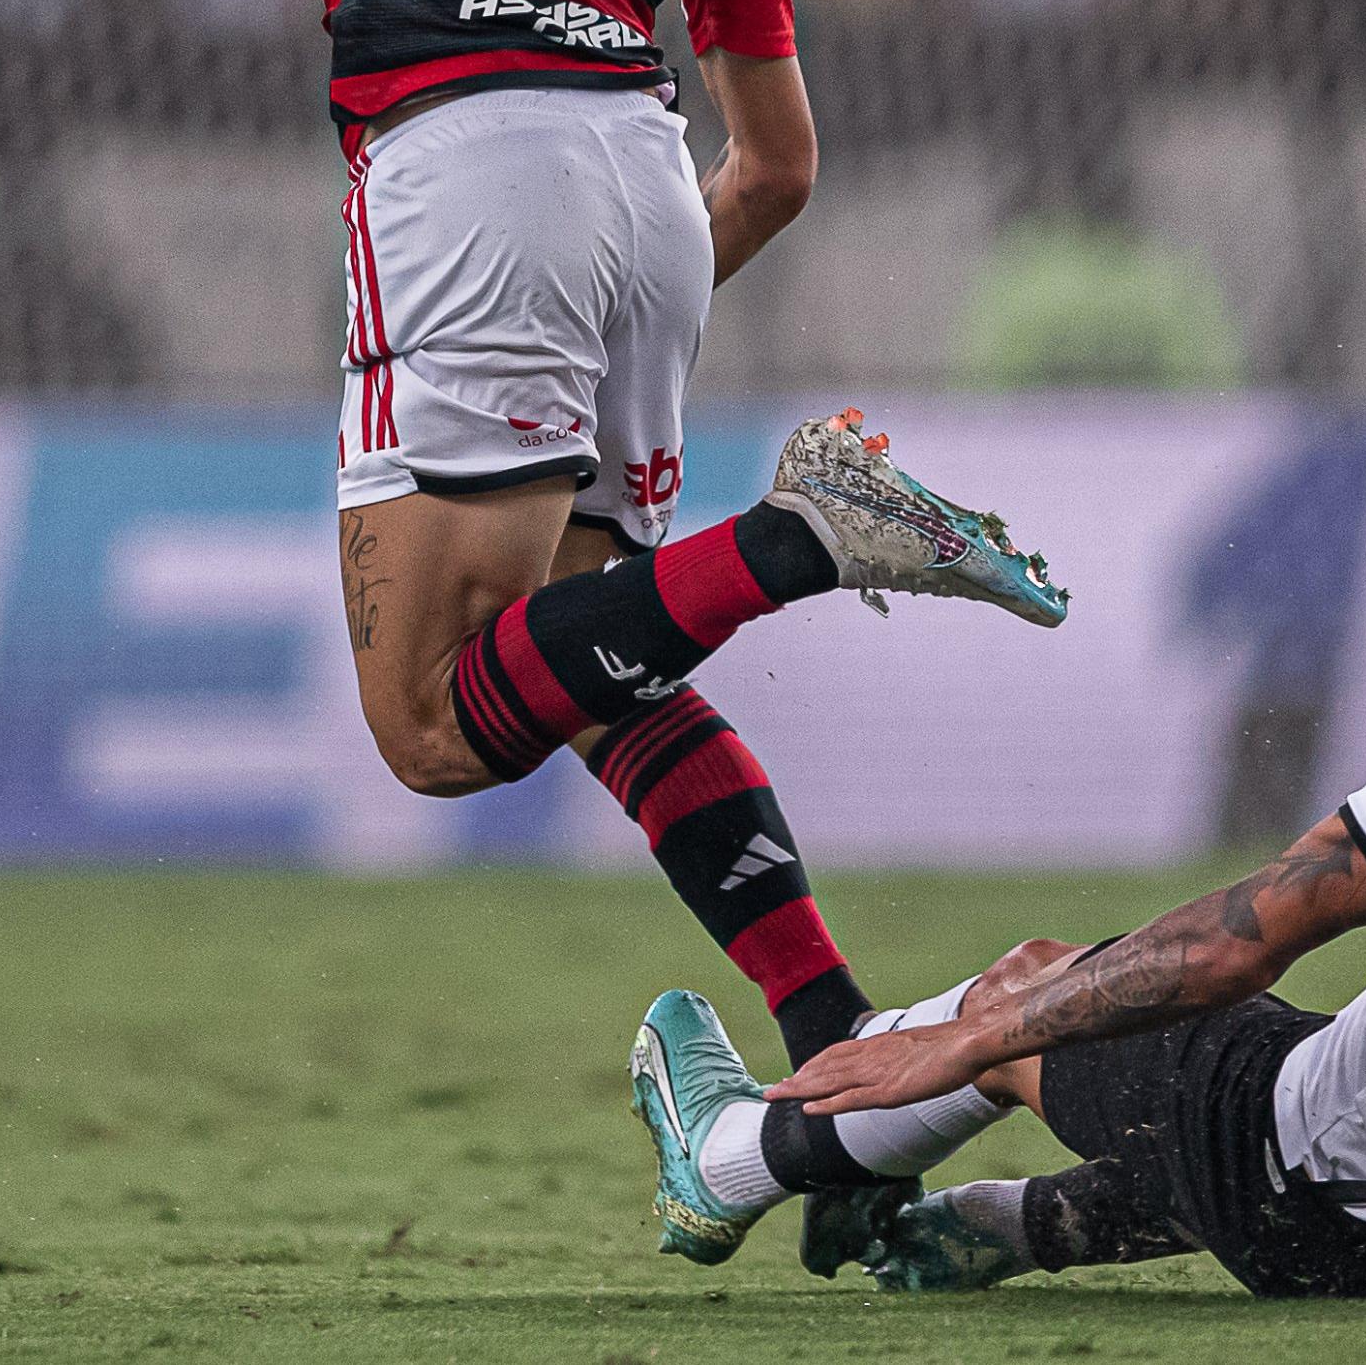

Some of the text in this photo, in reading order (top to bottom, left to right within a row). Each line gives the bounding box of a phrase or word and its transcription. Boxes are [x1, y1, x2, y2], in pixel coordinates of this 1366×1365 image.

[518, 426, 573, 449] da co
[624, 443, 684, 508] ab
